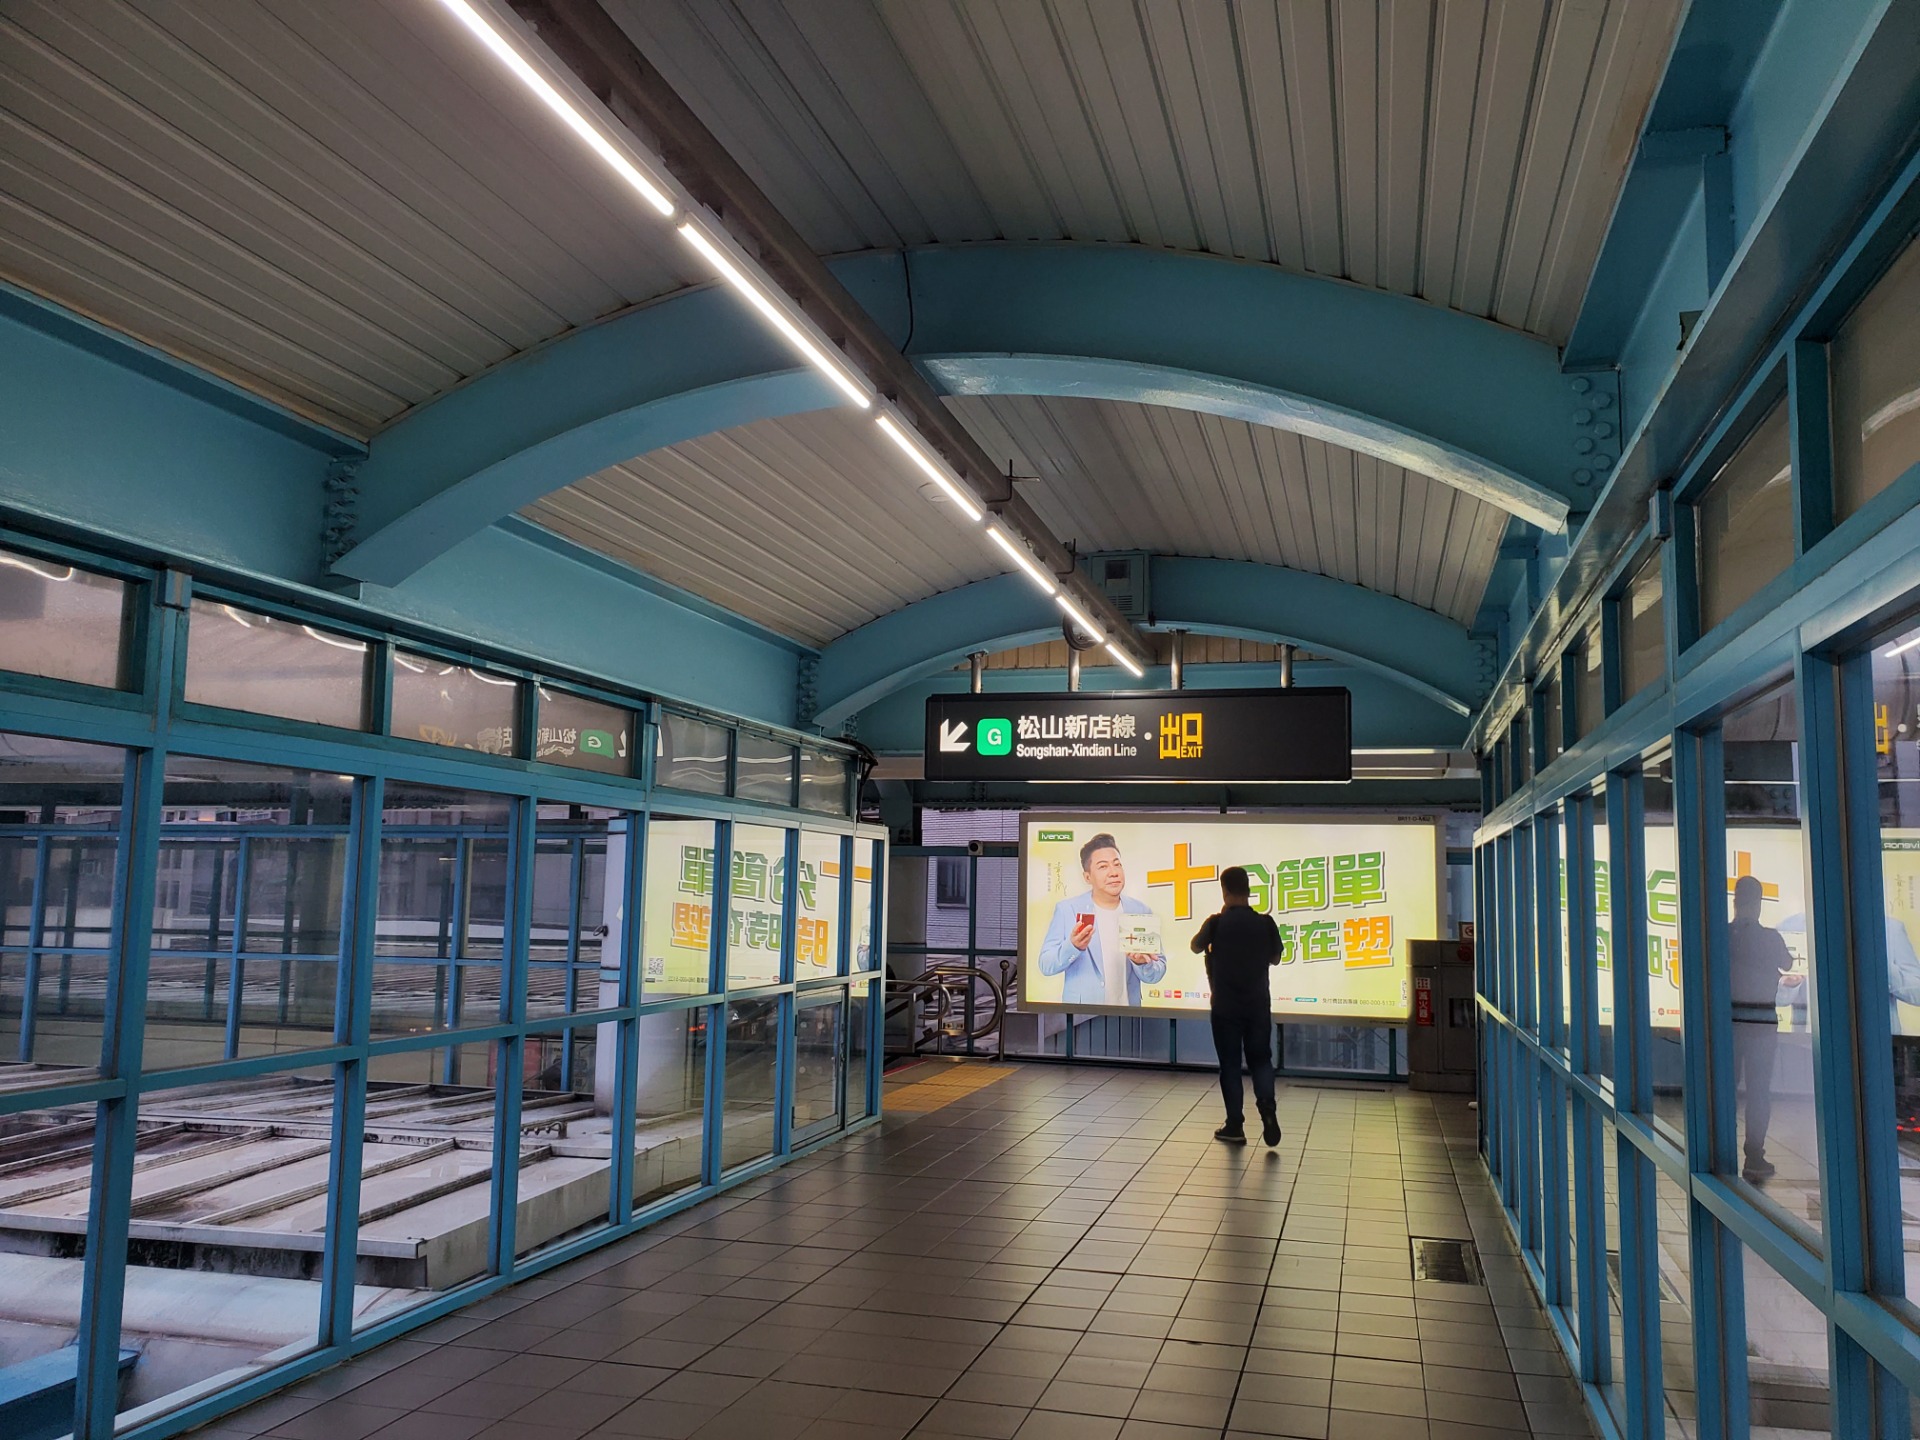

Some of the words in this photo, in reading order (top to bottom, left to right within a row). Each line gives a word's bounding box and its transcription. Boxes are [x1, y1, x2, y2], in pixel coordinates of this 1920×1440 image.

[1016, 714, 1137, 740] 松山新店線
[1159, 712, 1203, 759] 出口
[987, 728, 1003, 746] G
[1016, 743, 1111, 759] Songshan-Xindian
[1113, 743, 1137, 757] Line
[1181, 745, 1203, 758] EXIT
